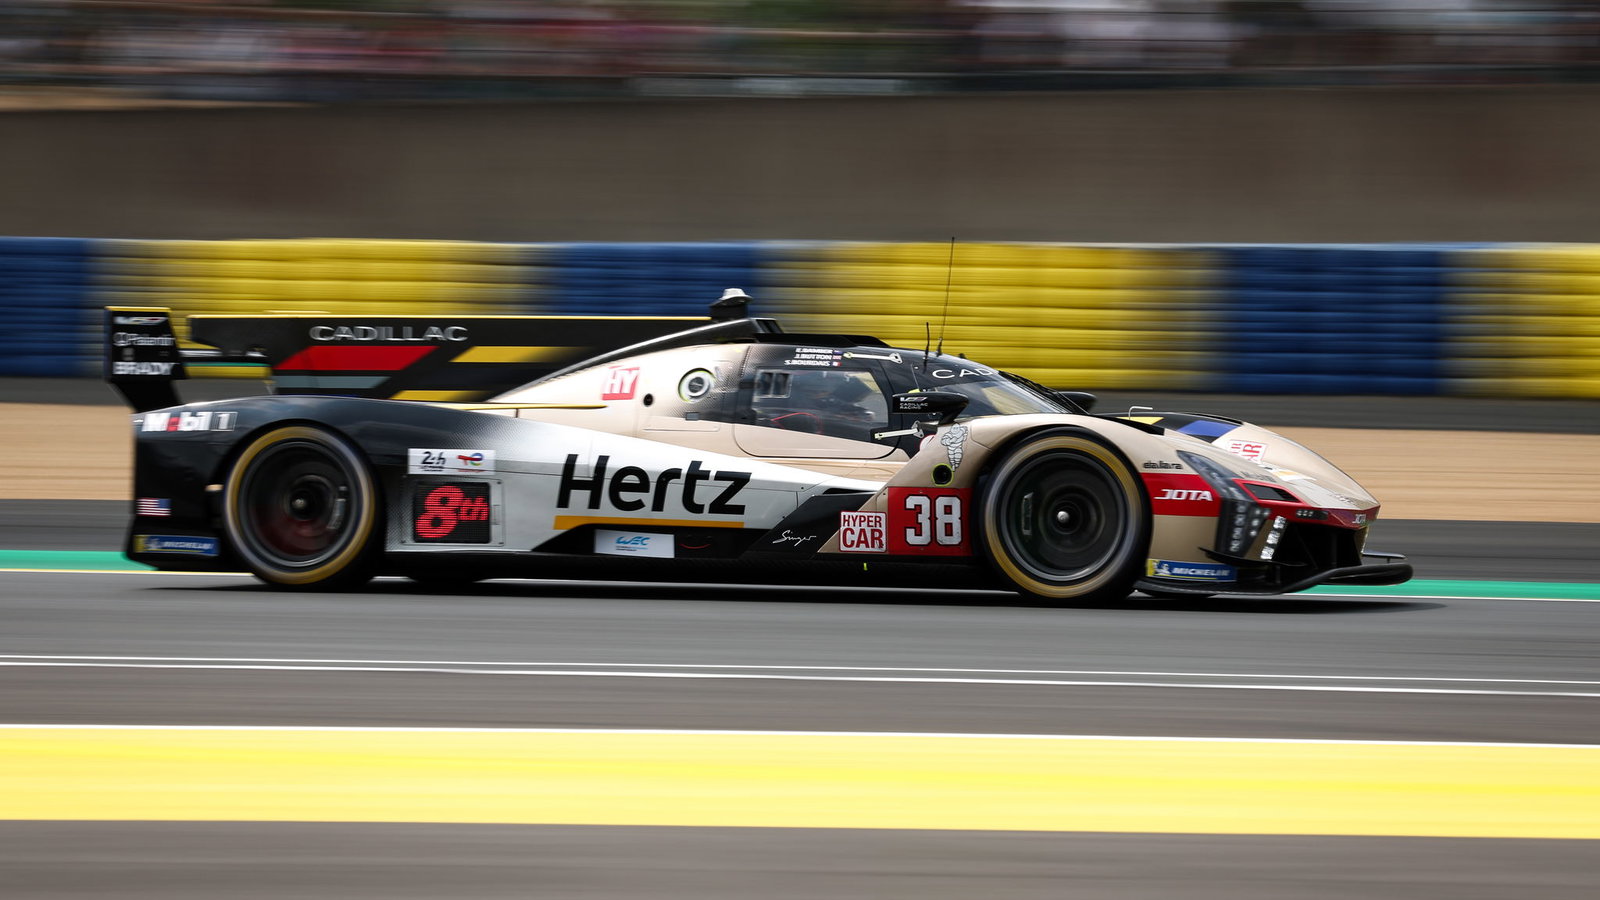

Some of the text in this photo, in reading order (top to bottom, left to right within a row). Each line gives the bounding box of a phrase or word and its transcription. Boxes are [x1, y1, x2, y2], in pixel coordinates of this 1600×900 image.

[309, 325, 468, 341] CADILLAC
[603, 368, 640, 394] HY
[556, 453, 752, 515] Hertz
[1154, 489, 1213, 502] JOTA
[415, 485, 489, 539] 8th
[904, 494, 962, 546] 38
[842, 514, 882, 528] HYPER
[163, 541, 215, 550] MICHELIN
[615, 535, 651, 546] WEC
[841, 527, 884, 549] CAR
[1171, 567, 1231, 577] MICHELIN
